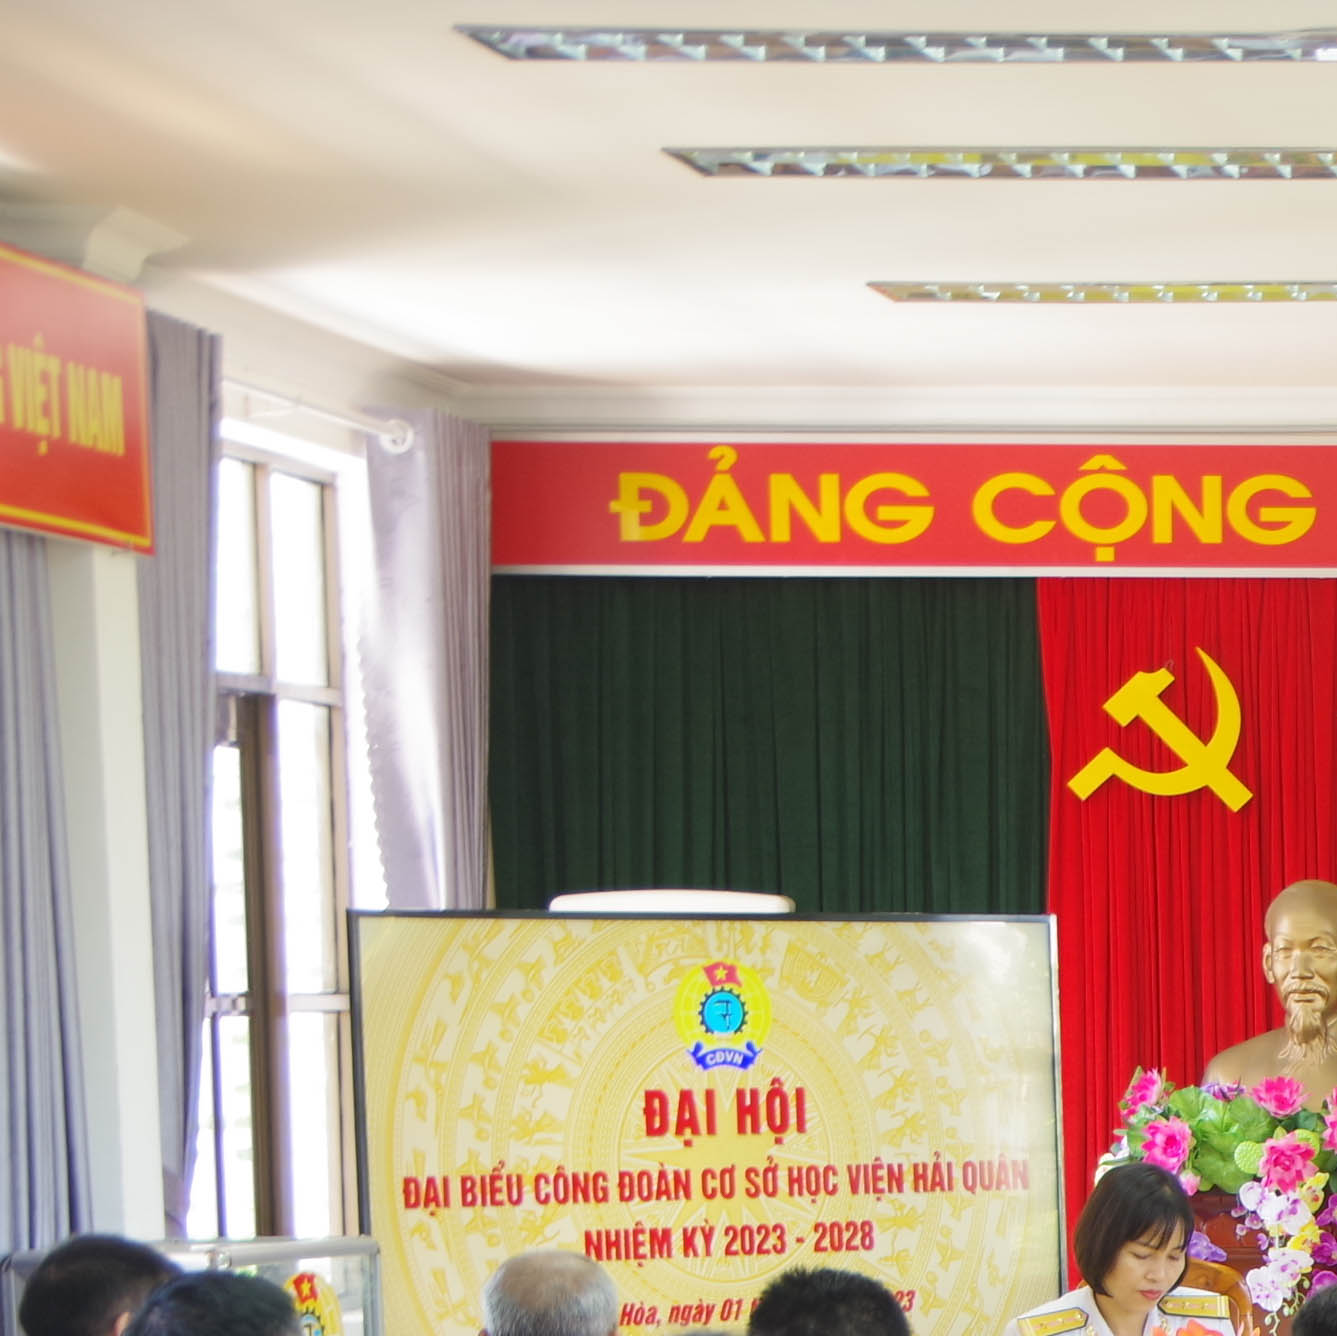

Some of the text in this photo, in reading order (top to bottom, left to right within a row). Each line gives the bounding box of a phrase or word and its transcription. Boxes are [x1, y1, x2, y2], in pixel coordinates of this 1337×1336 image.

[7, 332, 62, 457] VIỆT
[66, 361, 125, 457] NAM
[609, 445, 935, 545] ĐẢNG
[972, 454, 1317, 562] CỘNG
[642, 1076, 807, 1148] ĐẠI HỘI
[402, 1151, 1030, 1217] ĐẠI BIỂU CÔNG ĐOÀN CƠ SỞ HỌC VIỆN HẢI QUÂN
[584, 1221, 673, 1268] NHIỆM
[682, 1218, 716, 1258] KỲ
[723, 1223, 787, 1257] 2023
[813, 1220, 876, 1252] 2028
[618, 1301, 662, 1328] Hòa,
[668, 1299, 716, 1327] ngày
[719, 1298, 743, 1322] 01
